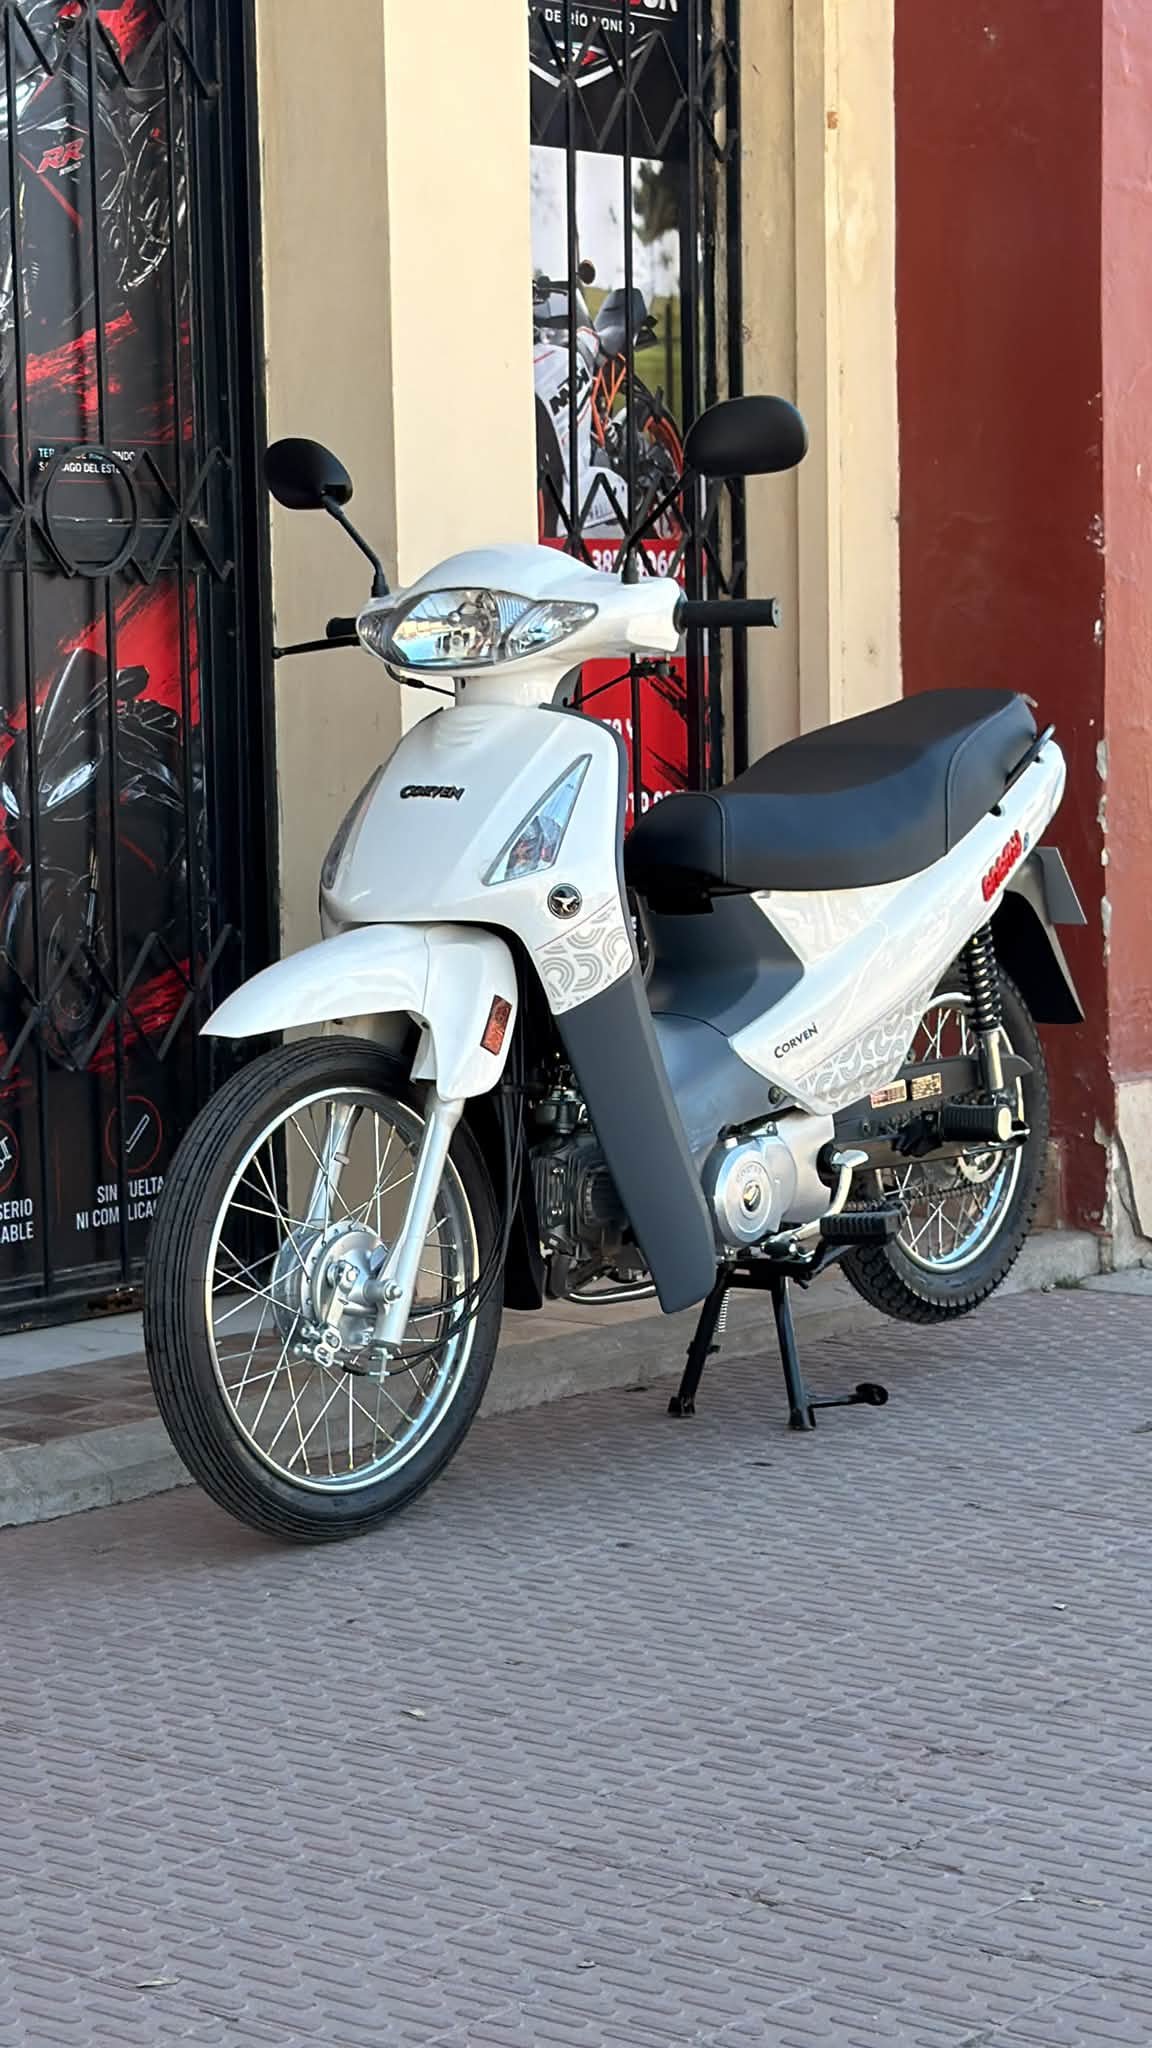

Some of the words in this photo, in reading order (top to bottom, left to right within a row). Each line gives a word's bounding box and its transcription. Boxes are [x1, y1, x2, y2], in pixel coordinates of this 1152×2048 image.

[544, 8, 562, 23] DE
[83, 463, 99, 474] DEL
[774, 1022, 819, 1059] CORVEN
[97, 1183, 118, 1204] SIN
[76, 1212, 89, 1231] NI
